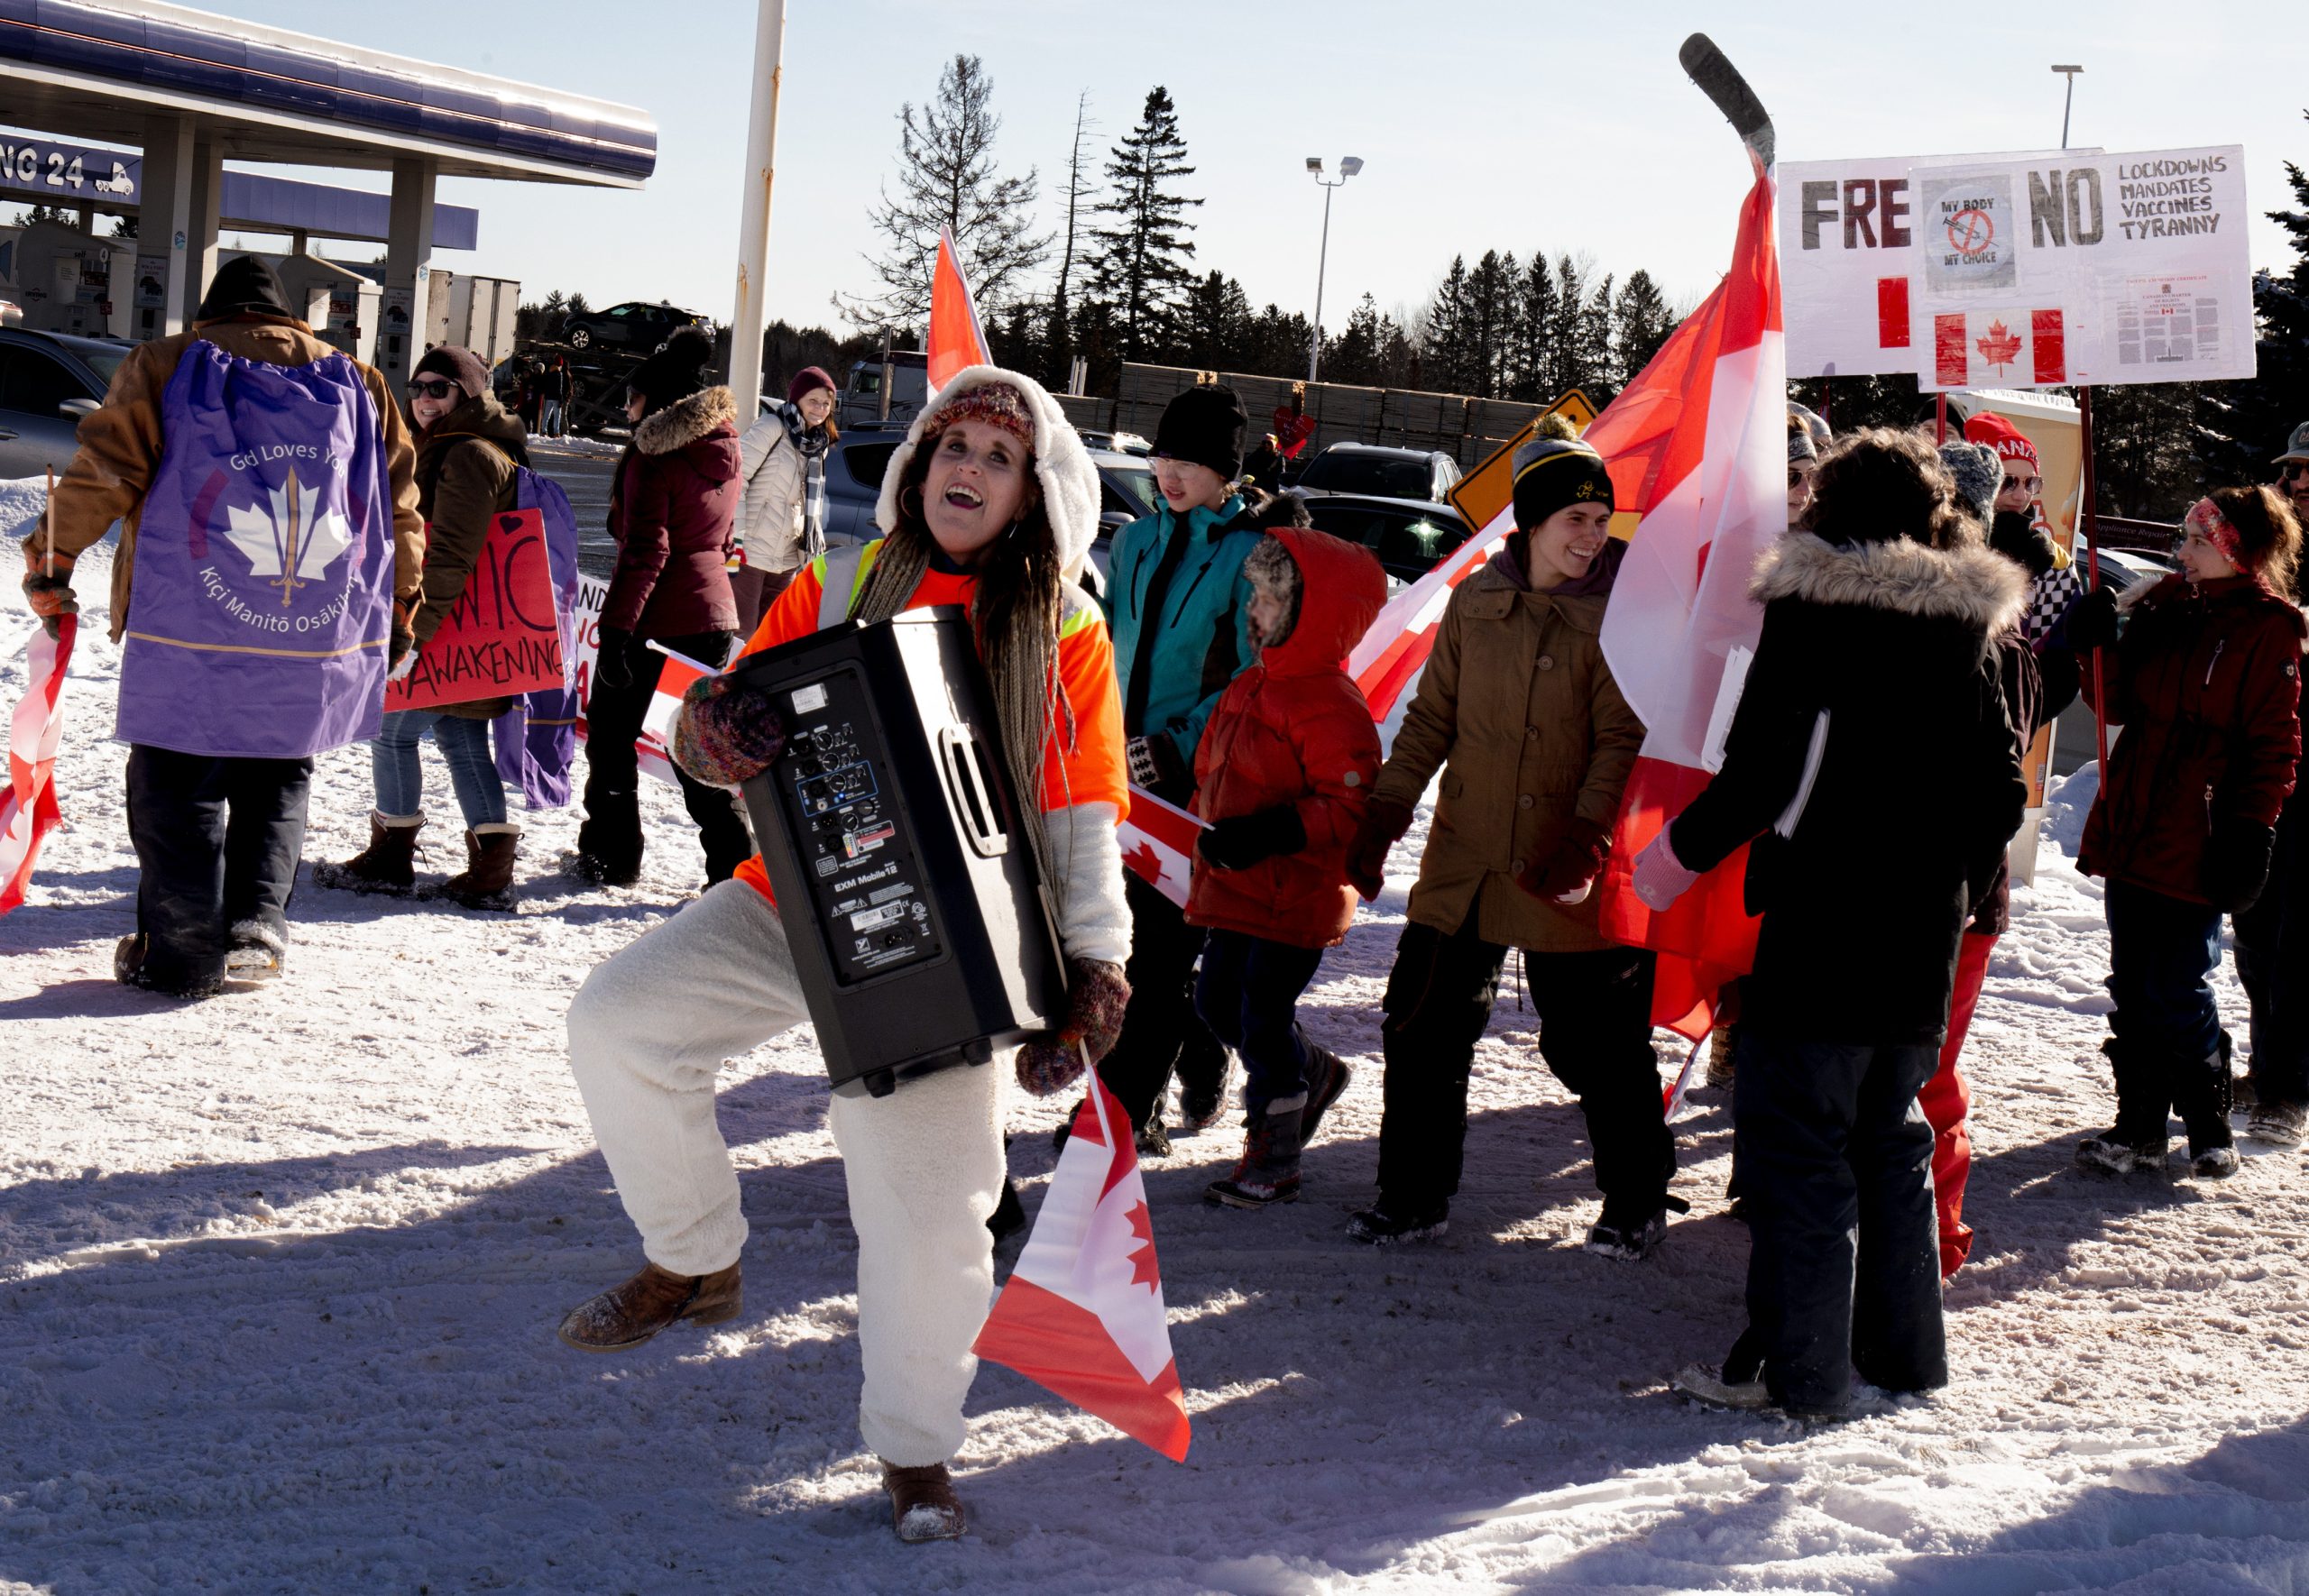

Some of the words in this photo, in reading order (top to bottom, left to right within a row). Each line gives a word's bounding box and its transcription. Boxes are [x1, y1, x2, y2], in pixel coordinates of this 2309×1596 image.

[47, 151, 84, 188] 24
[2119, 156, 2228, 180] LOCKDOWNS
[2120, 177, 2212, 200] MANDATES
[1941, 201, 1958, 213] MY
[1963, 197, 1995, 211] BODY
[2028, 167, 2104, 248] NO
[2120, 196, 2212, 218] VACCINES
[2120, 213, 2221, 240] TYRANNY
[1945, 253, 1959, 266] MY
[1962, 251, 1997, 265] CHOICE
[261, 445, 318, 462] Loves
[325, 447, 345, 479] You
[406, 637, 564, 700] AWAKENING
[834, 878, 857, 893] EXM
